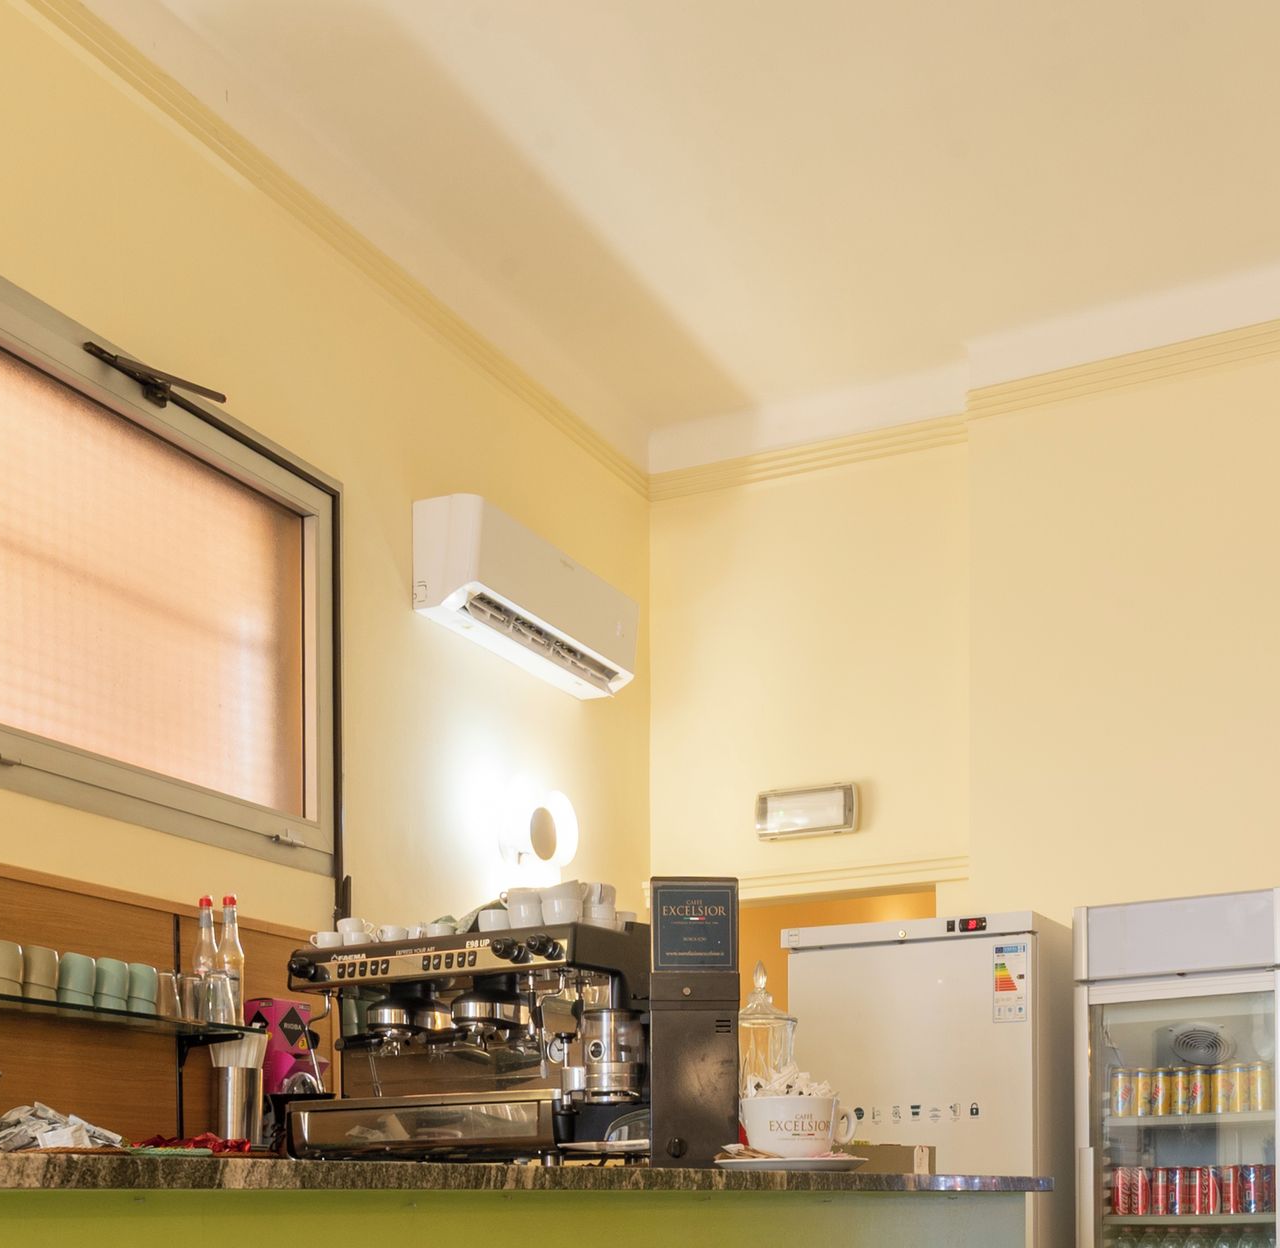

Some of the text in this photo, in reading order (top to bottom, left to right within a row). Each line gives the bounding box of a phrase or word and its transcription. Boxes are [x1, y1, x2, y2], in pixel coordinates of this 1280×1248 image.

[662, 905, 726, 916] EXCELSIOR
[466, 939, 491, 948] E98 UP
[337, 953, 366, 962] FAEMA
[769, 1120, 831, 1132] EXCELSIOR
